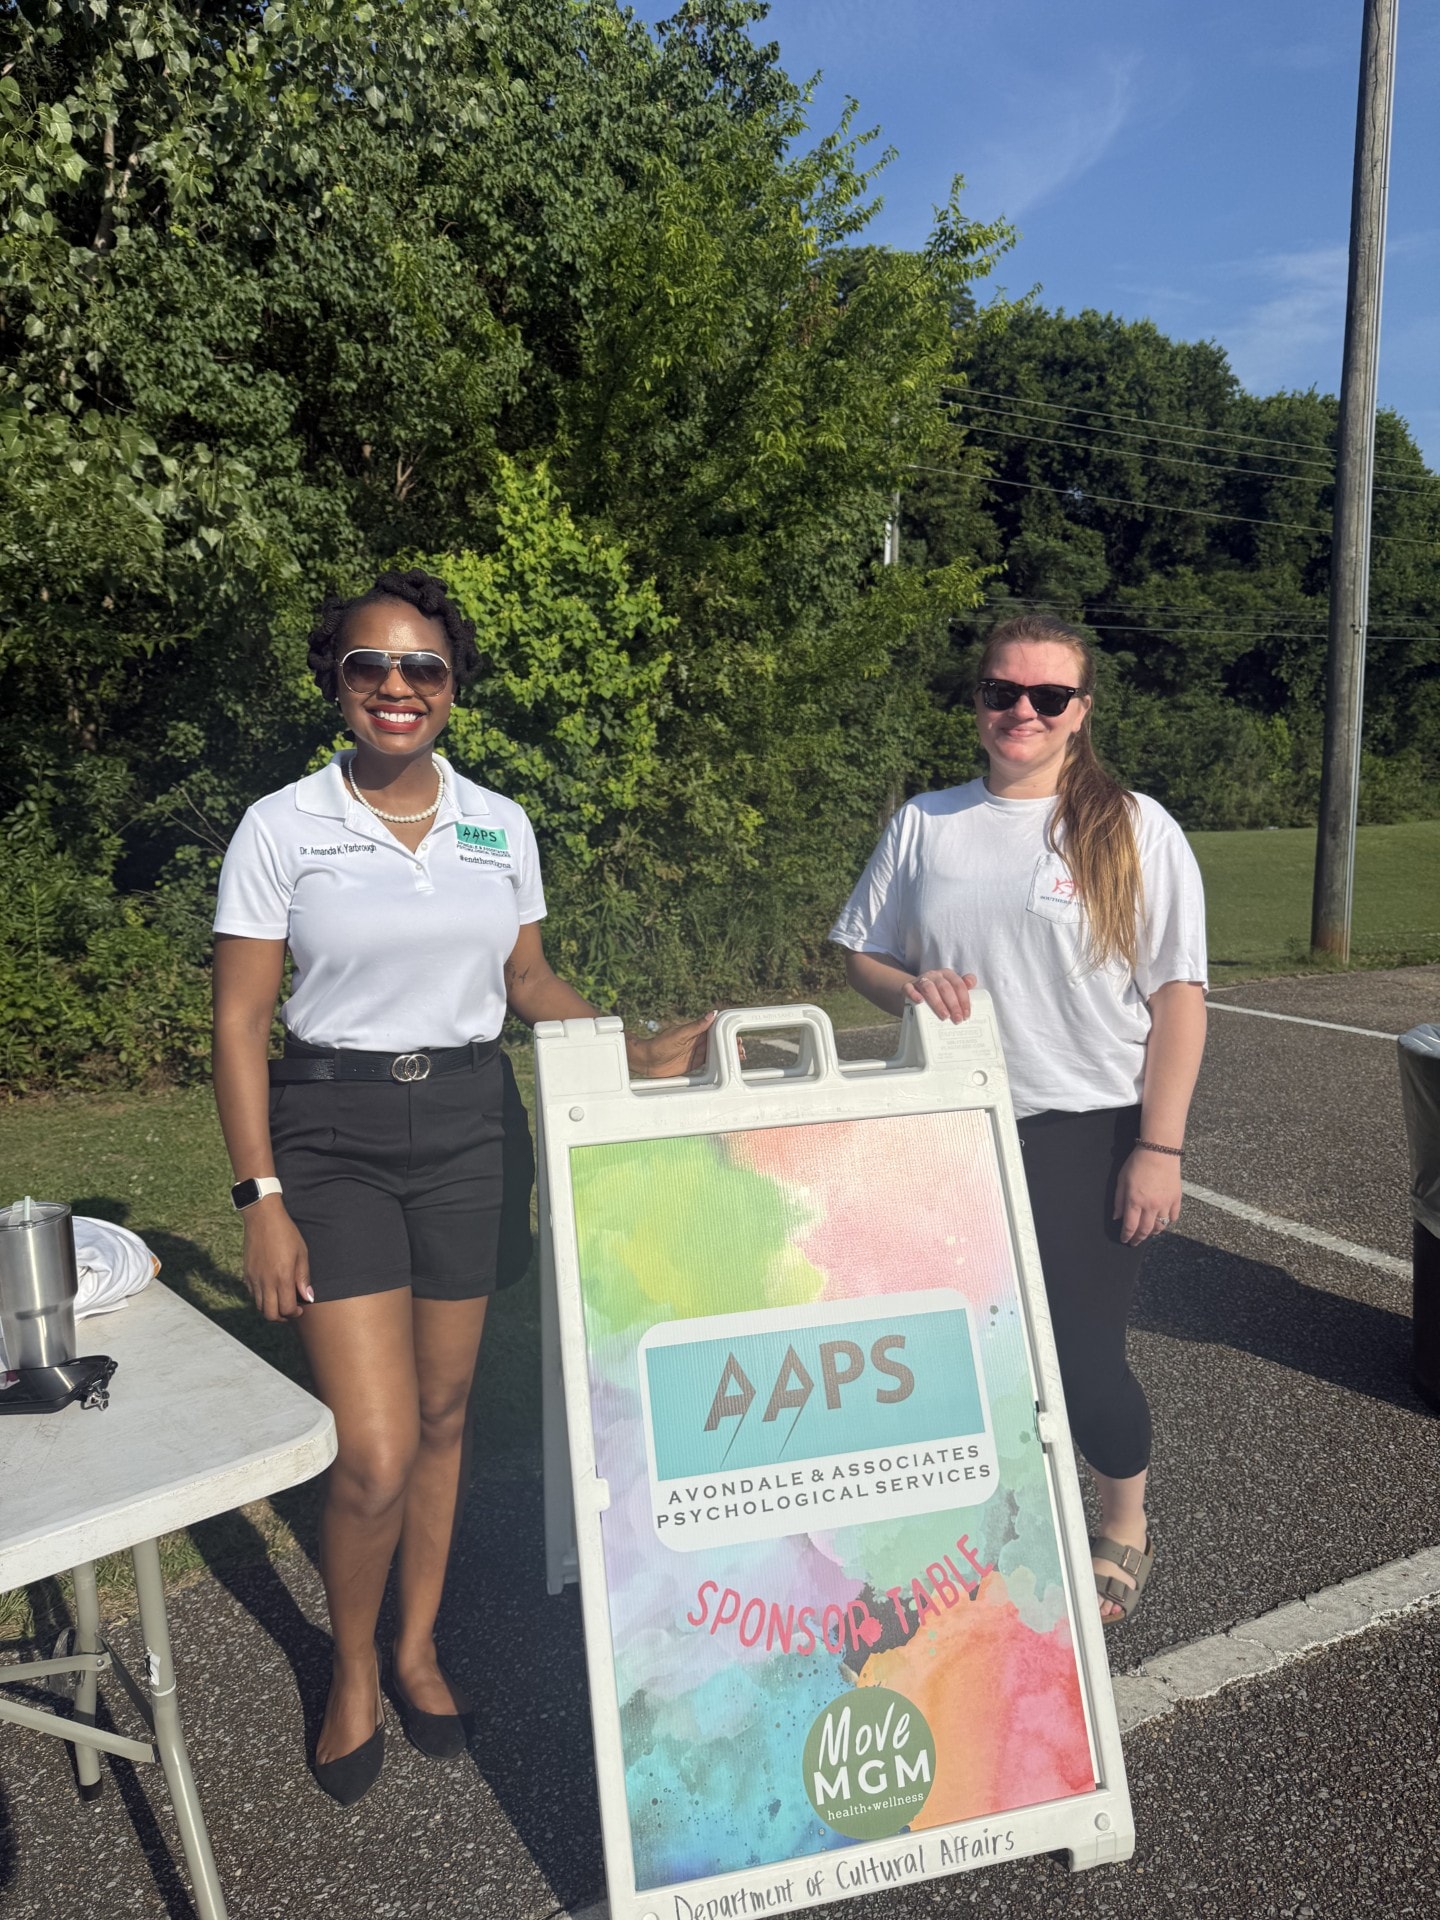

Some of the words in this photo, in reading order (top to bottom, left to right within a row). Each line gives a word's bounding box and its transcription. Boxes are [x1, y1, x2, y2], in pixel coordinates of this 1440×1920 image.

[299, 846, 310, 855] Dr.
[310, 846, 337, 856] Amanda
[337, 845, 344, 854] K.
[344, 843, 376, 853] Yarbrough
[463, 826, 497, 844] AAPS
[703, 1334, 915, 1467] AAPS
[656, 1482, 869, 1529] PSYCHOLOGICAL
[875, 1463, 992, 1495] SERVICES
[667, 1471, 803, 1505] AVONDALE
[810, 1468, 824, 1483] &
[831, 1443, 981, 1480] ASSOCIATES
[887, 1534, 994, 1634] TABLE
[818, 1702, 911, 1768] Move
[813, 1748, 932, 1806] MGM
[674, 1877, 795, 1920] Department
[806, 1869, 826, 1898] of
[836, 1843, 925, 1891] Cultural
[940, 1828, 1016, 1867] Affairs
